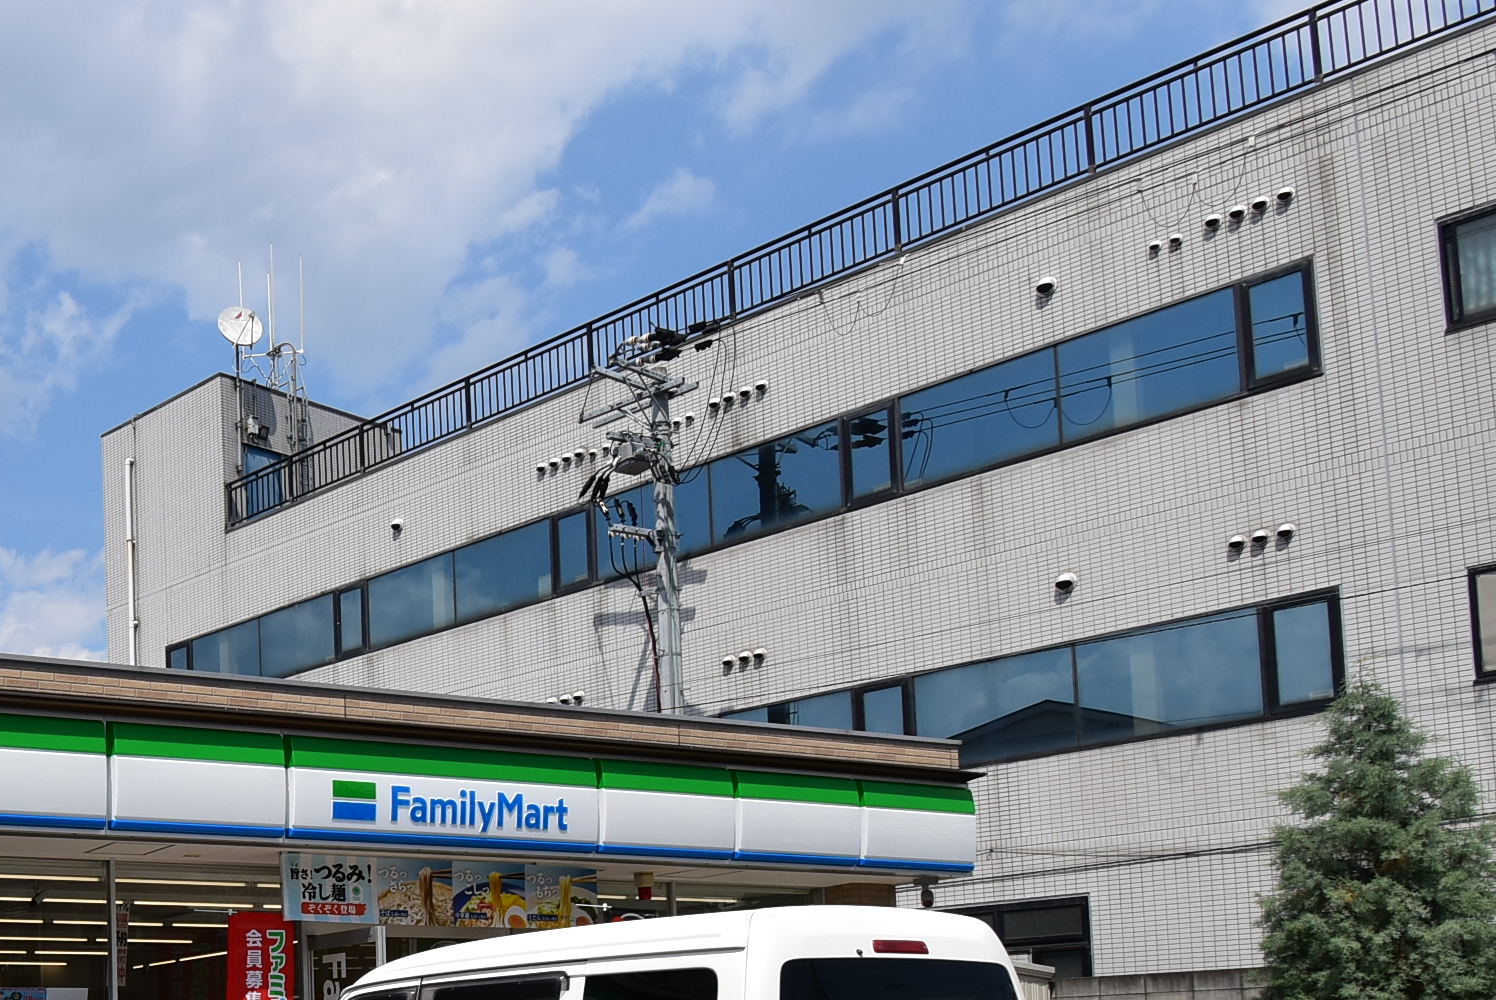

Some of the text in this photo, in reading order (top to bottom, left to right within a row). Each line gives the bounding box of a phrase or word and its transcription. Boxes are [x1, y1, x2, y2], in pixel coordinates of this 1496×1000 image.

[390, 785, 568, 833] FamilyMart
[378, 865, 408, 879] つるっ
[453, 870, 481, 882] つるっ
[526, 873, 552, 885] つるっ
[302, 882, 346, 901] 冷し麺
[389, 881, 415, 893] さらっ
[464, 884, 490, 895] こしっ
[536, 886, 560, 898] もちっ
[307, 905, 356, 915] ぞくぞく登場
